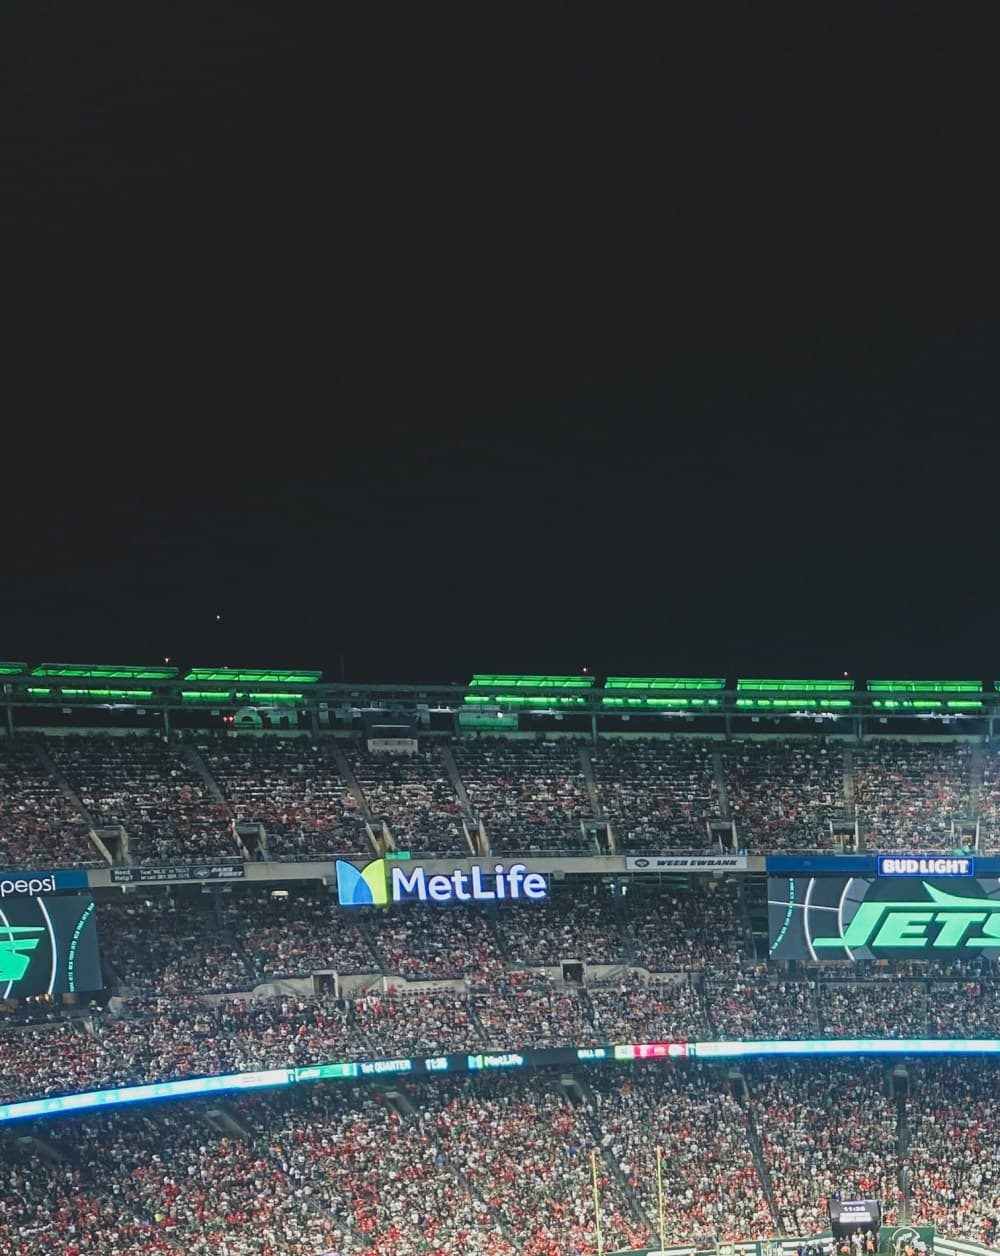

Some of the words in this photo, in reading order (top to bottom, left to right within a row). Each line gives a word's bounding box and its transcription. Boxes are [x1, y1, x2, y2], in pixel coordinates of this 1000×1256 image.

[882, 858, 919, 874] BUD
[919, 858, 970, 874] LIGHT
[0, 874, 56, 898] pepsi
[391, 863, 548, 901] MetLife
[374, 1059, 412, 1073] QUARTER
